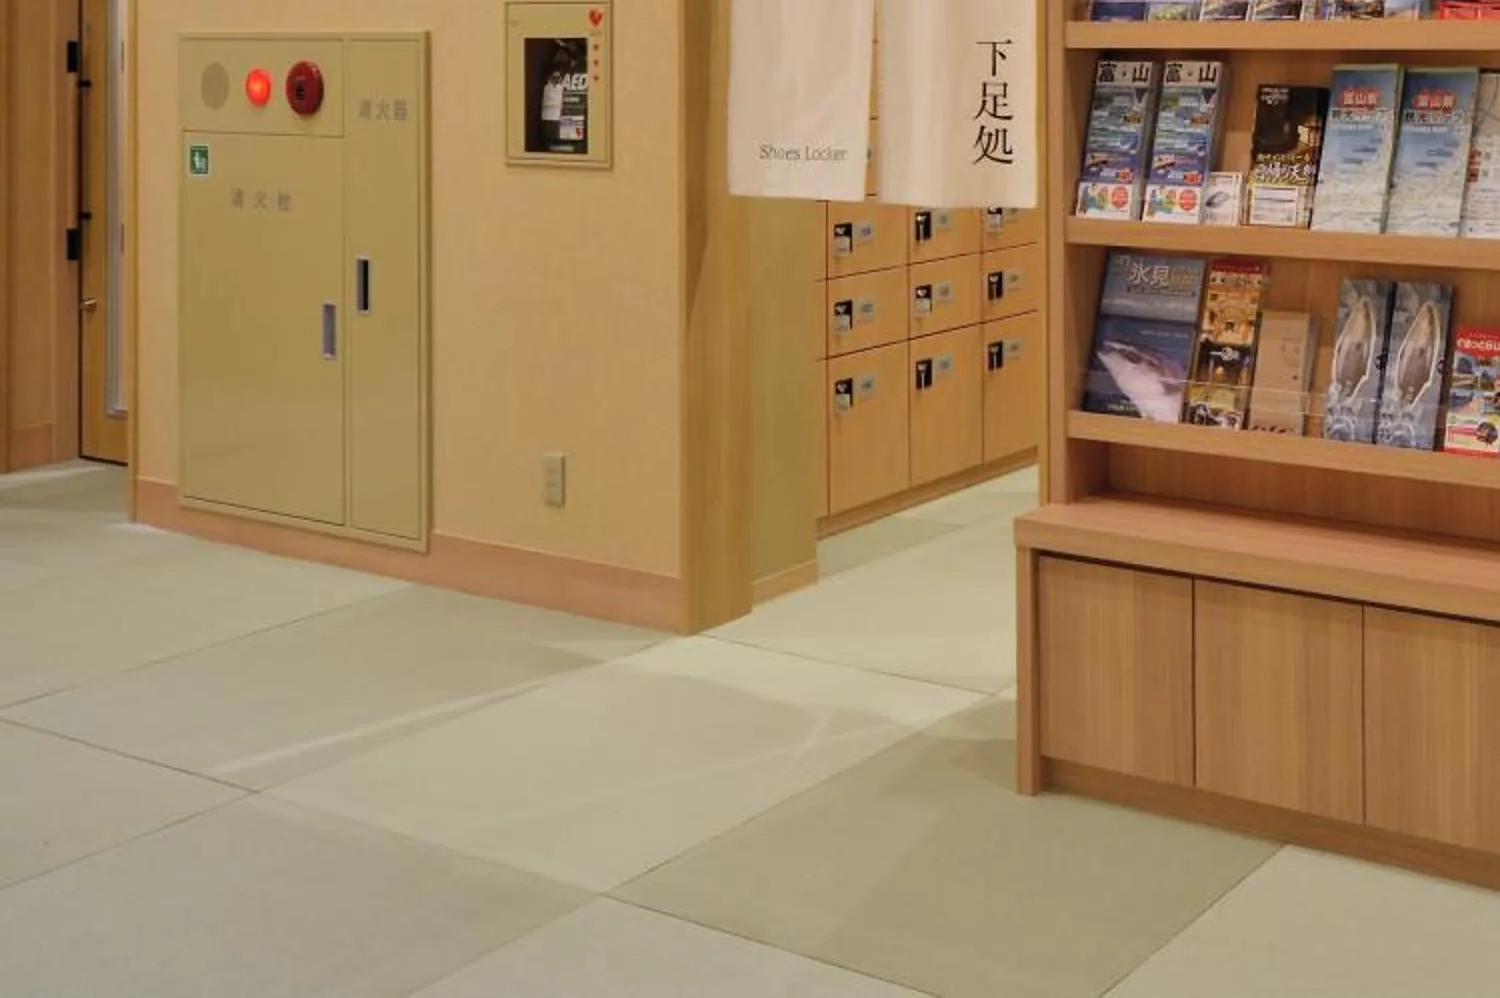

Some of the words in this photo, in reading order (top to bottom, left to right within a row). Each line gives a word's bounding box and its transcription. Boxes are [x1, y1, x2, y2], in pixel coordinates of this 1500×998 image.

[561, 73, 588, 91] AED
[972, 38, 1014, 166] 下足処
[758, 143, 801, 160] Shoes
[804, 145, 848, 162] Locker
[1128, 261, 1171, 287] 氷見
